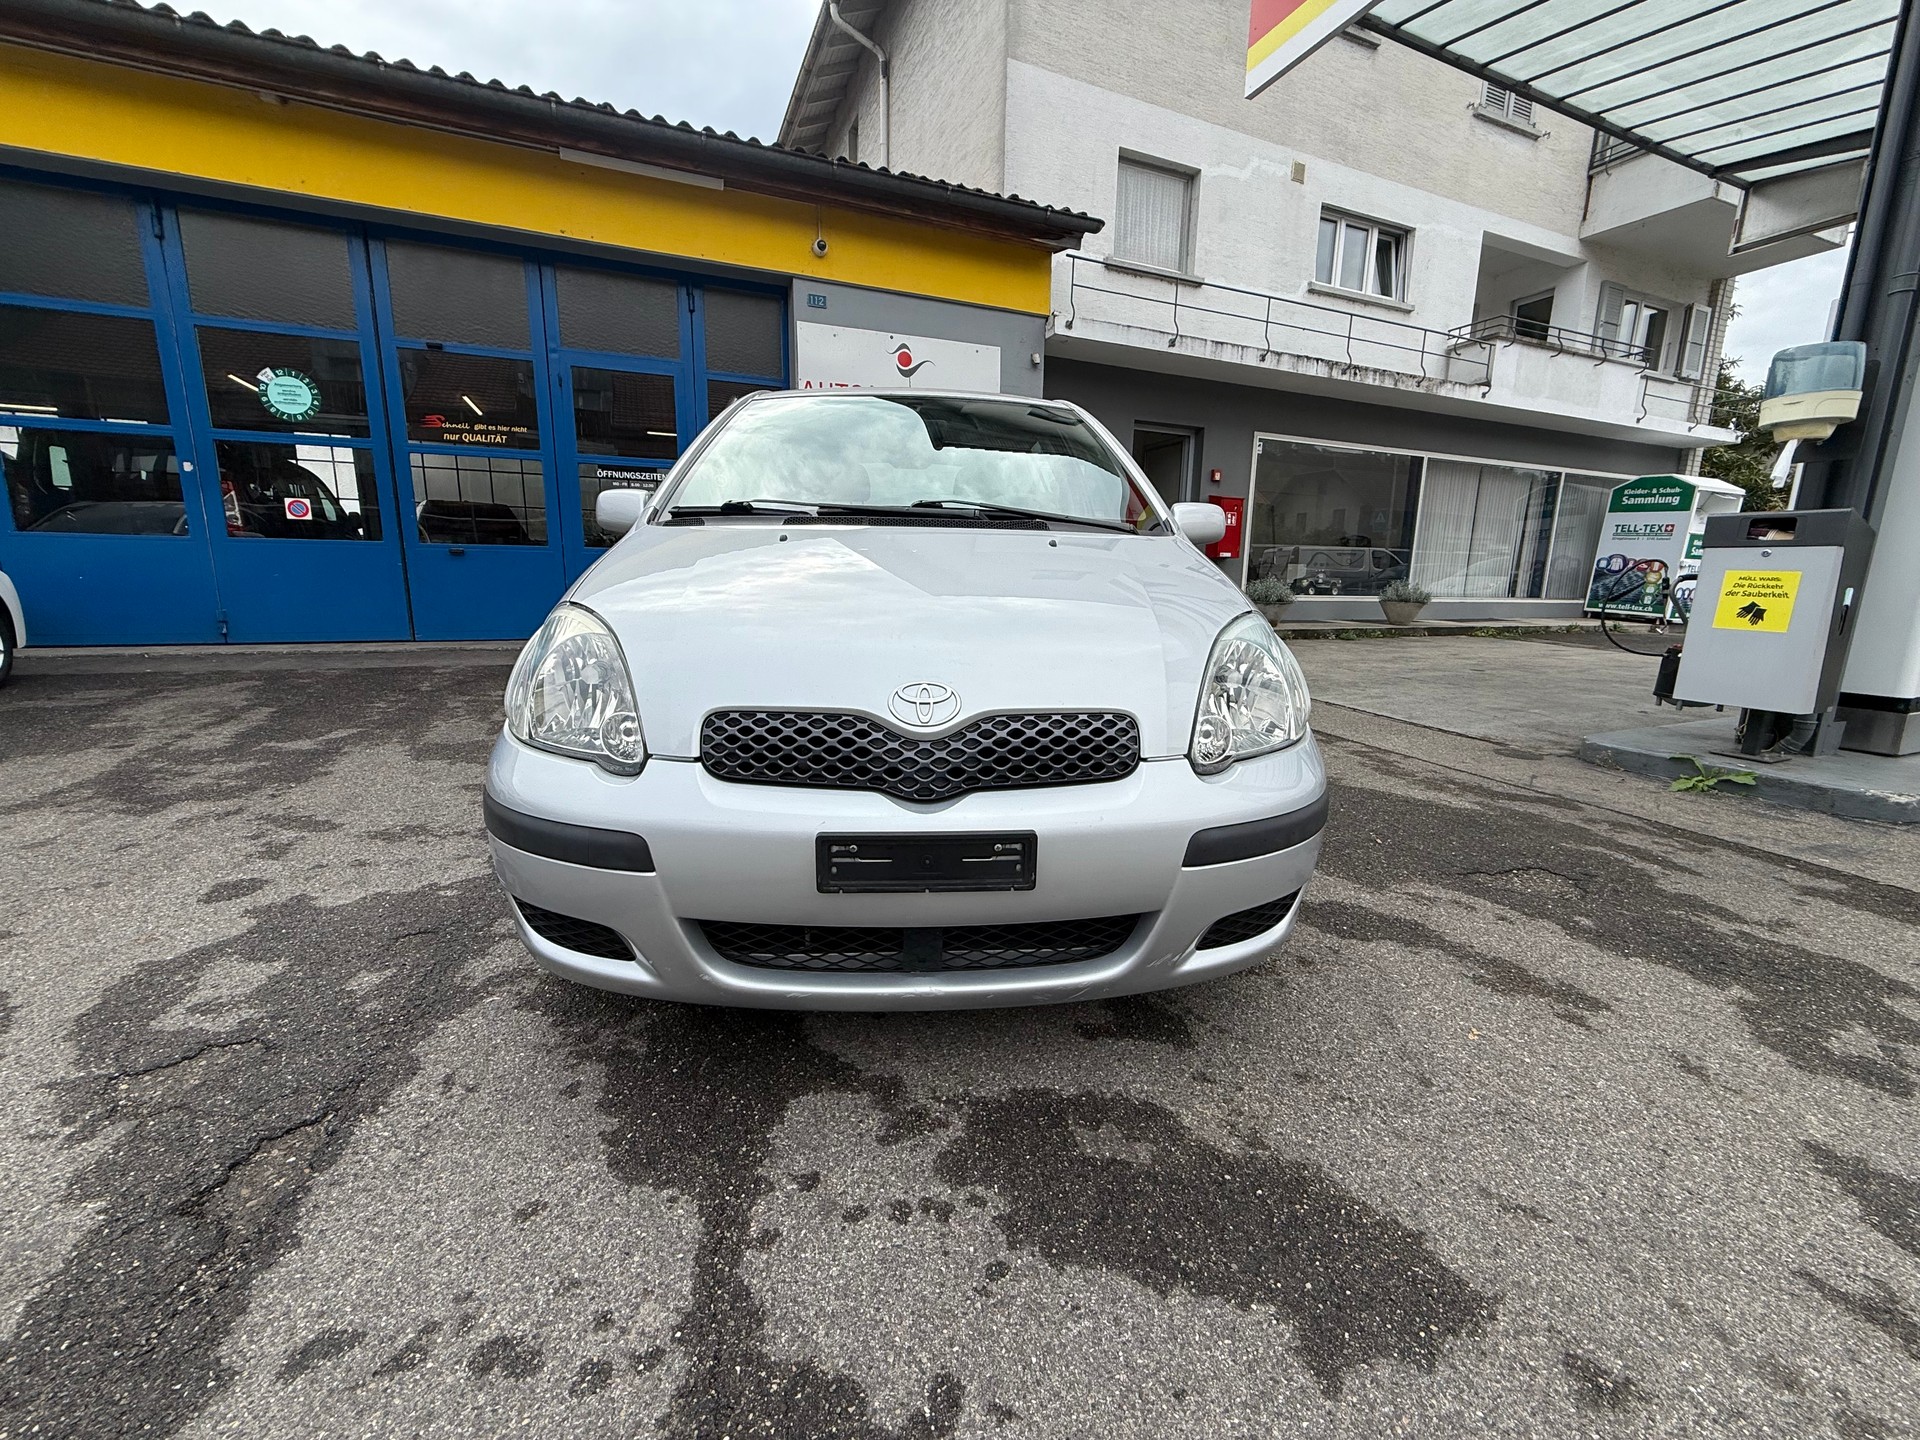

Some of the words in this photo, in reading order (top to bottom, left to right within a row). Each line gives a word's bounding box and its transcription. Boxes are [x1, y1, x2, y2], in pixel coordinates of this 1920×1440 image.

[810, 295, 824, 306] 112
[421, 414, 471, 429] Schnell
[474, 423, 487, 431] gibt
[497, 424, 510, 432] hier
[443, 432, 460, 441] nur
[461, 432, 508, 444] QUALITÄT
[596, 468, 668, 481] ÖFFNUNGSZEITEN
[1659, 486, 1683, 494] Schuh-
[1621, 494, 1681, 506] Sammlung
[1614, 523, 1665, 533] TELL-TEX
[1747, 582, 1784, 590] Rückkehr
[1725, 589, 1740, 597] der
[1740, 590, 1790, 599] Sauberkeit
